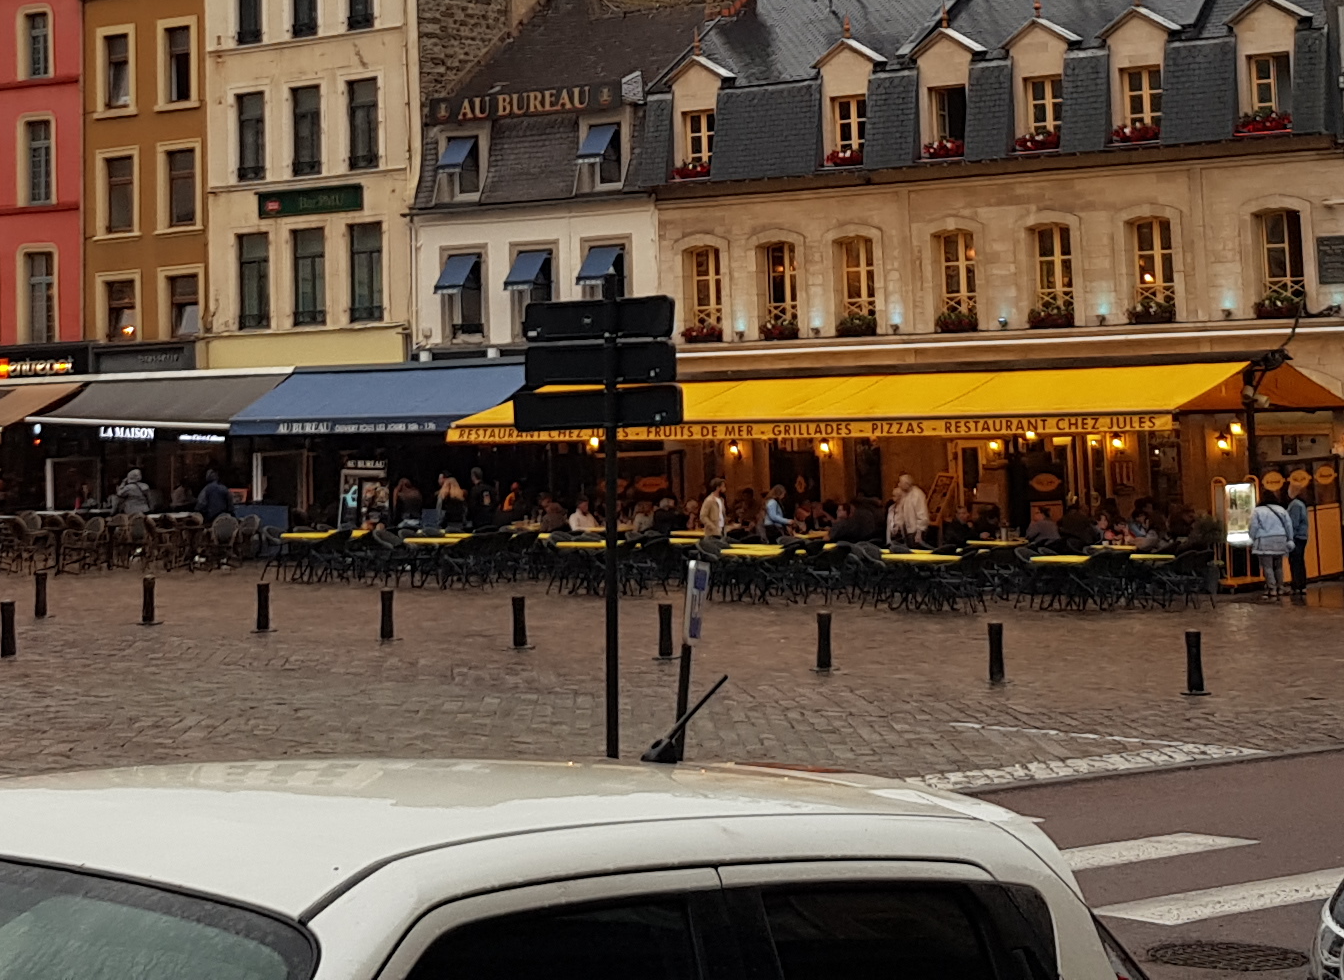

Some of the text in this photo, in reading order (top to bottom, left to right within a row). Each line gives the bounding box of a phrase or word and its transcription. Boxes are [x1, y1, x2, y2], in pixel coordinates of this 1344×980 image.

[458, 86, 591, 120] AU BUREAU
[99, 426, 155, 440] LA MAISON
[276, 422, 292, 434] AU
[292, 422, 332, 433] BUREAU
[458, 427, 541, 440] RESTAURANT
[646, 425, 694, 438] FRUITS
[701, 425, 718, 438] DE
[724, 424, 754, 437] MER
[771, 422, 853, 437] GRILLADES
[871, 421, 925, 435] PIZZAS
[944, 418, 1049, 434] RESTAURANT
[1056, 417, 1100, 431] CHEZ
[1107, 415, 1156, 430] JULES
